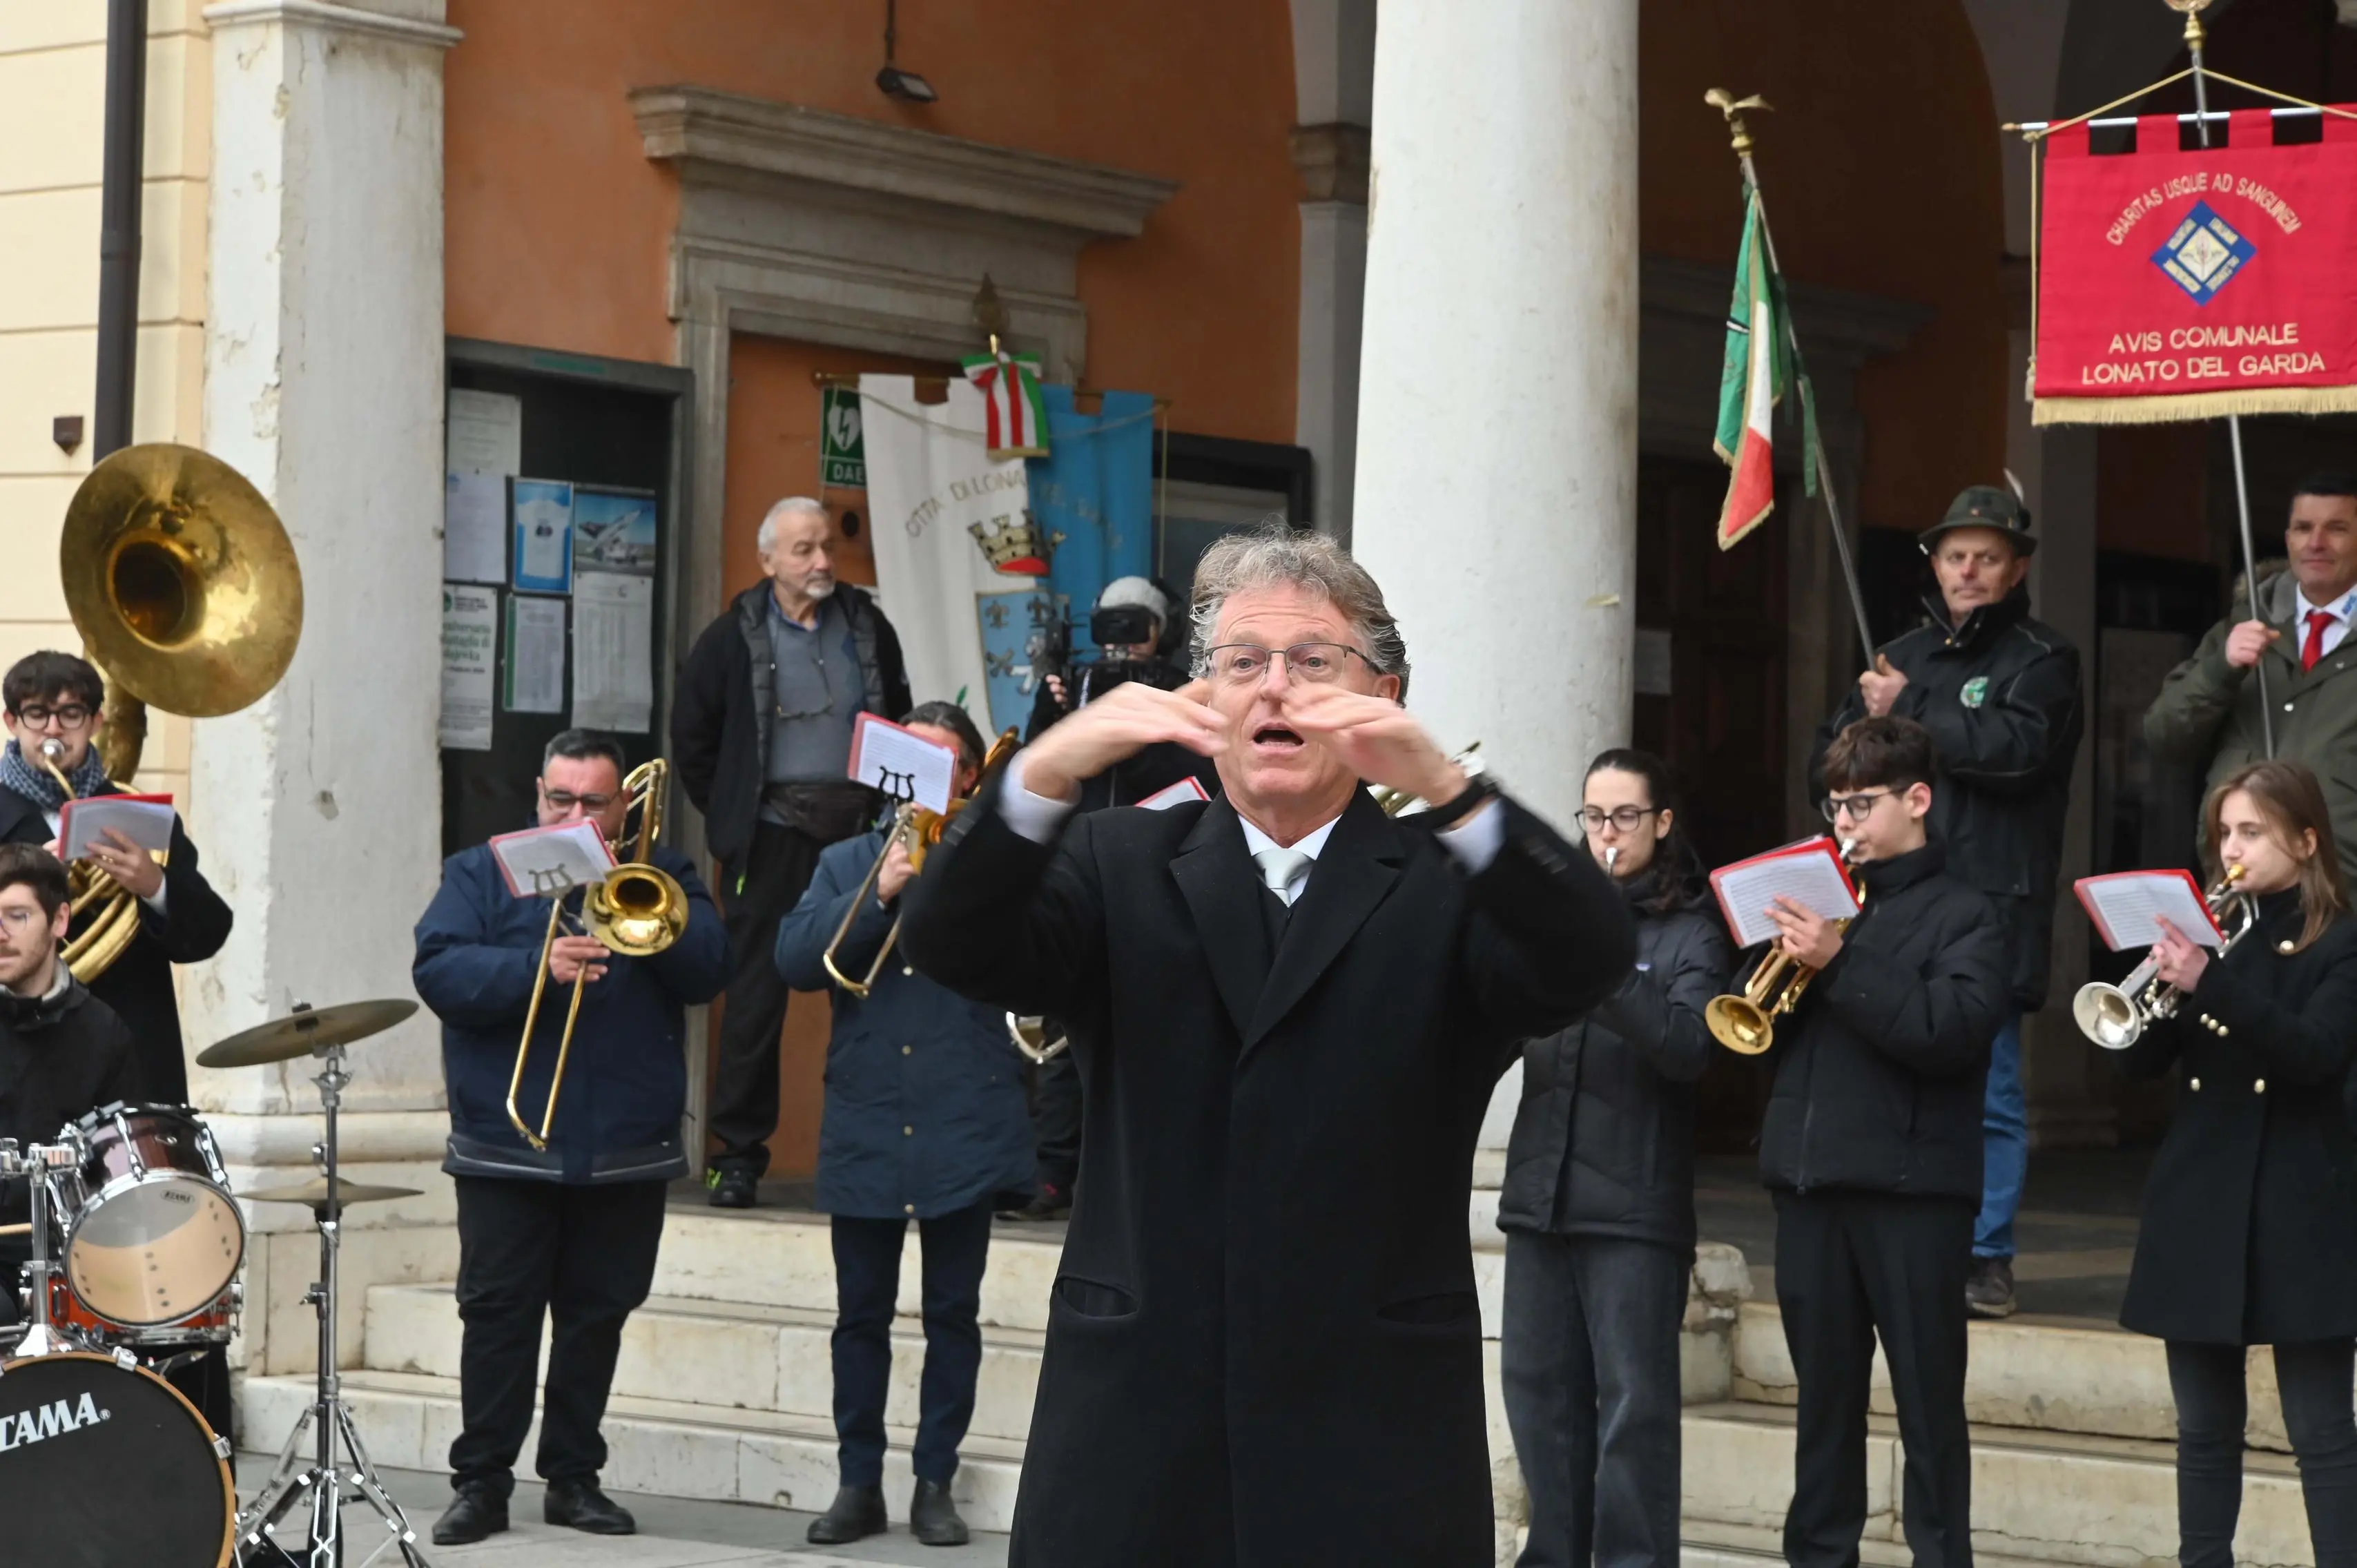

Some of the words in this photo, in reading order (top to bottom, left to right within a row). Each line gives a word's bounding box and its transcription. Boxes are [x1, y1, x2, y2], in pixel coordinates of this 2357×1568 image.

[2106, 188, 2163, 246] CHARITAS
[2163, 172, 2208, 199] USQUE
[2211, 173, 2233, 193] AD
[2108, 331, 2162, 355] AVIS
[2169, 322, 2299, 350] COMUNALE
[2082, 359, 2180, 385] LONATO
[2186, 356, 2231, 379] DEL
[2238, 351, 2326, 376] GARDA
